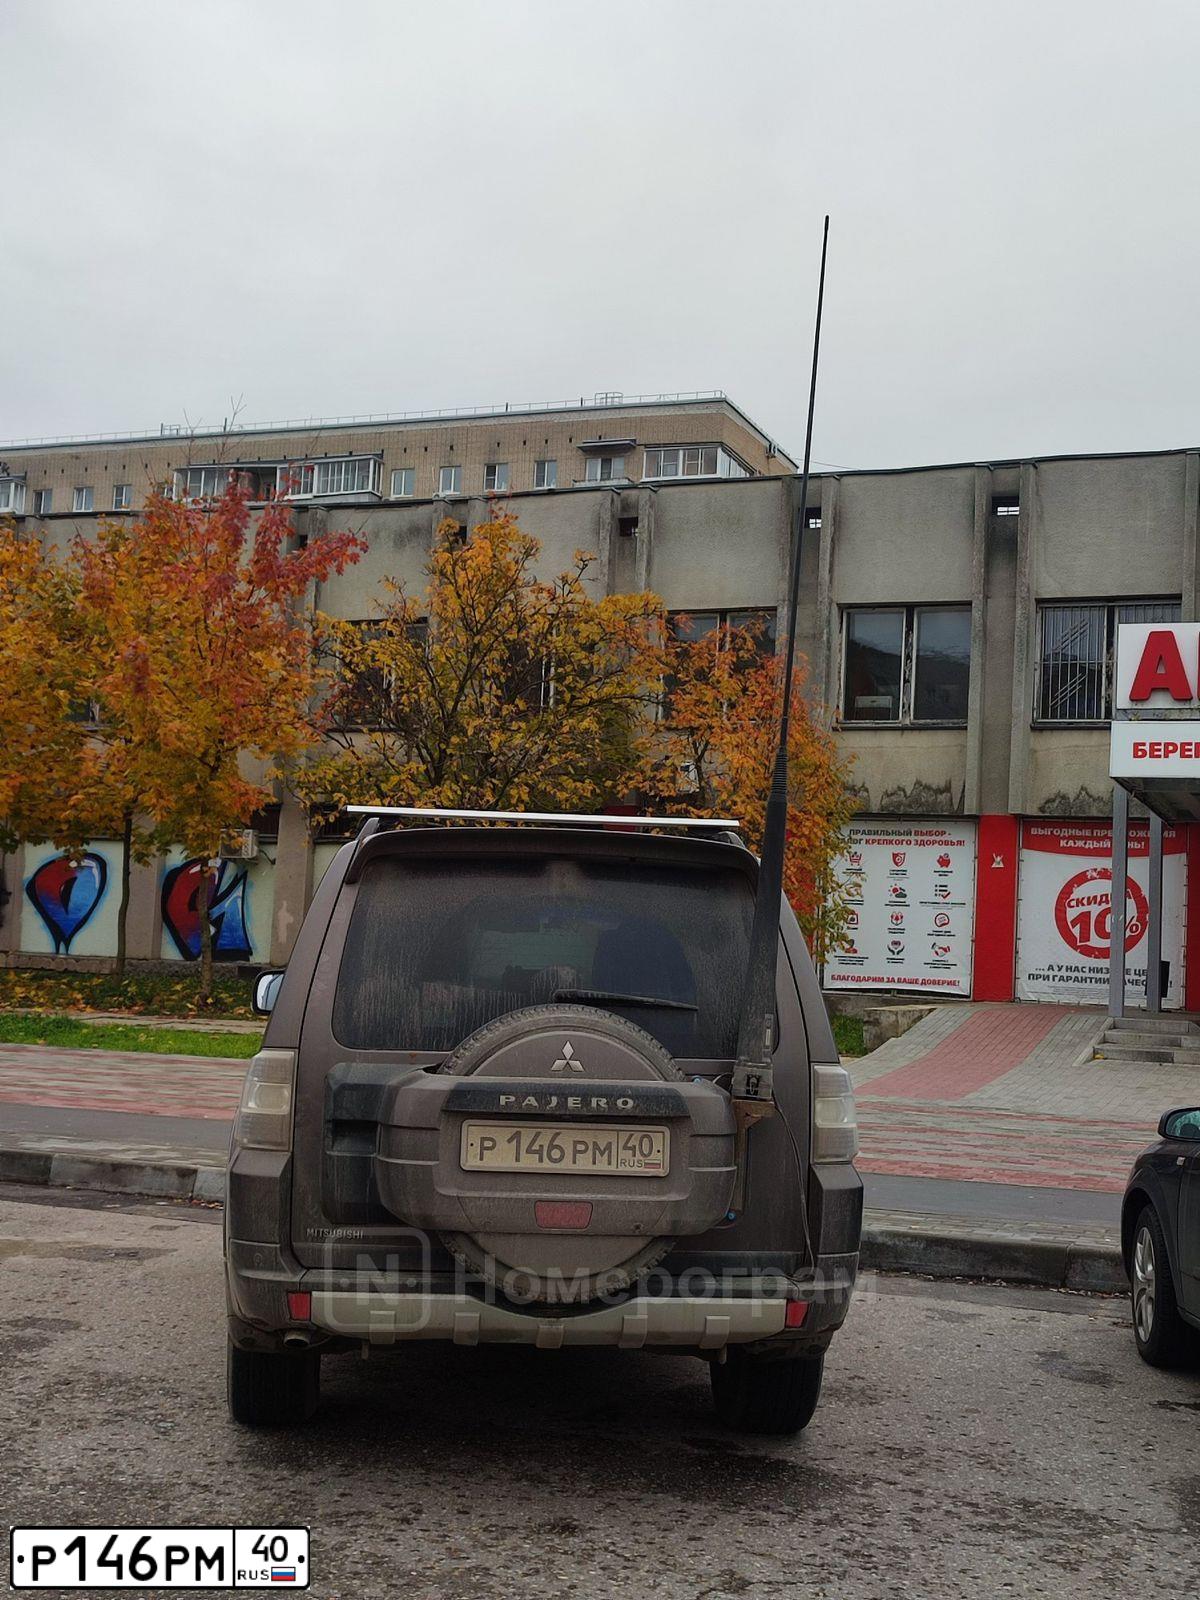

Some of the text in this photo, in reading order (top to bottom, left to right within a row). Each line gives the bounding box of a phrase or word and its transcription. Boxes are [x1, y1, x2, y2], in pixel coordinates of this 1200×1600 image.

[1129, 630, 1200, 702] А
[849, 828, 912, 837] ПРАВИЛЬНЫЙ
[914, 829, 946, 837] ВЫБОР
[1031, 827, 1176, 838] ВЫГОДНЫЕ ПРЕОЖИЯ
[865, 838, 912, 846] КРЕПКОГО
[914, 838, 965, 847] ЗДОРОВЬЯ!
[1060, 839, 1111, 849] КАЖДЫЙ
[1067, 889, 1132, 909] СКИДА
[1047, 964, 1055, 972] А
[1055, 965, 1064, 973] У
[1065, 965, 1087, 973] НАС
[1088, 966, 1132, 976] НИЗЕ
[831, 974, 885, 983] БЛАГОДАРИМ
[897, 977, 920, 985] ВАШЕ
[921, 977, 960, 986] ДОВЕРИЕ!
[1028, 973, 1051, 982] ПРИ
[1052, 974, 1110, 985] ГАРАНТИИ
[499, 1094, 634, 1110] PAJERO
[622, 1133, 654, 1158] 40
[619, 1158, 644, 1168] RUS
[306, 1228, 364, 1239] MITSUBISHI
